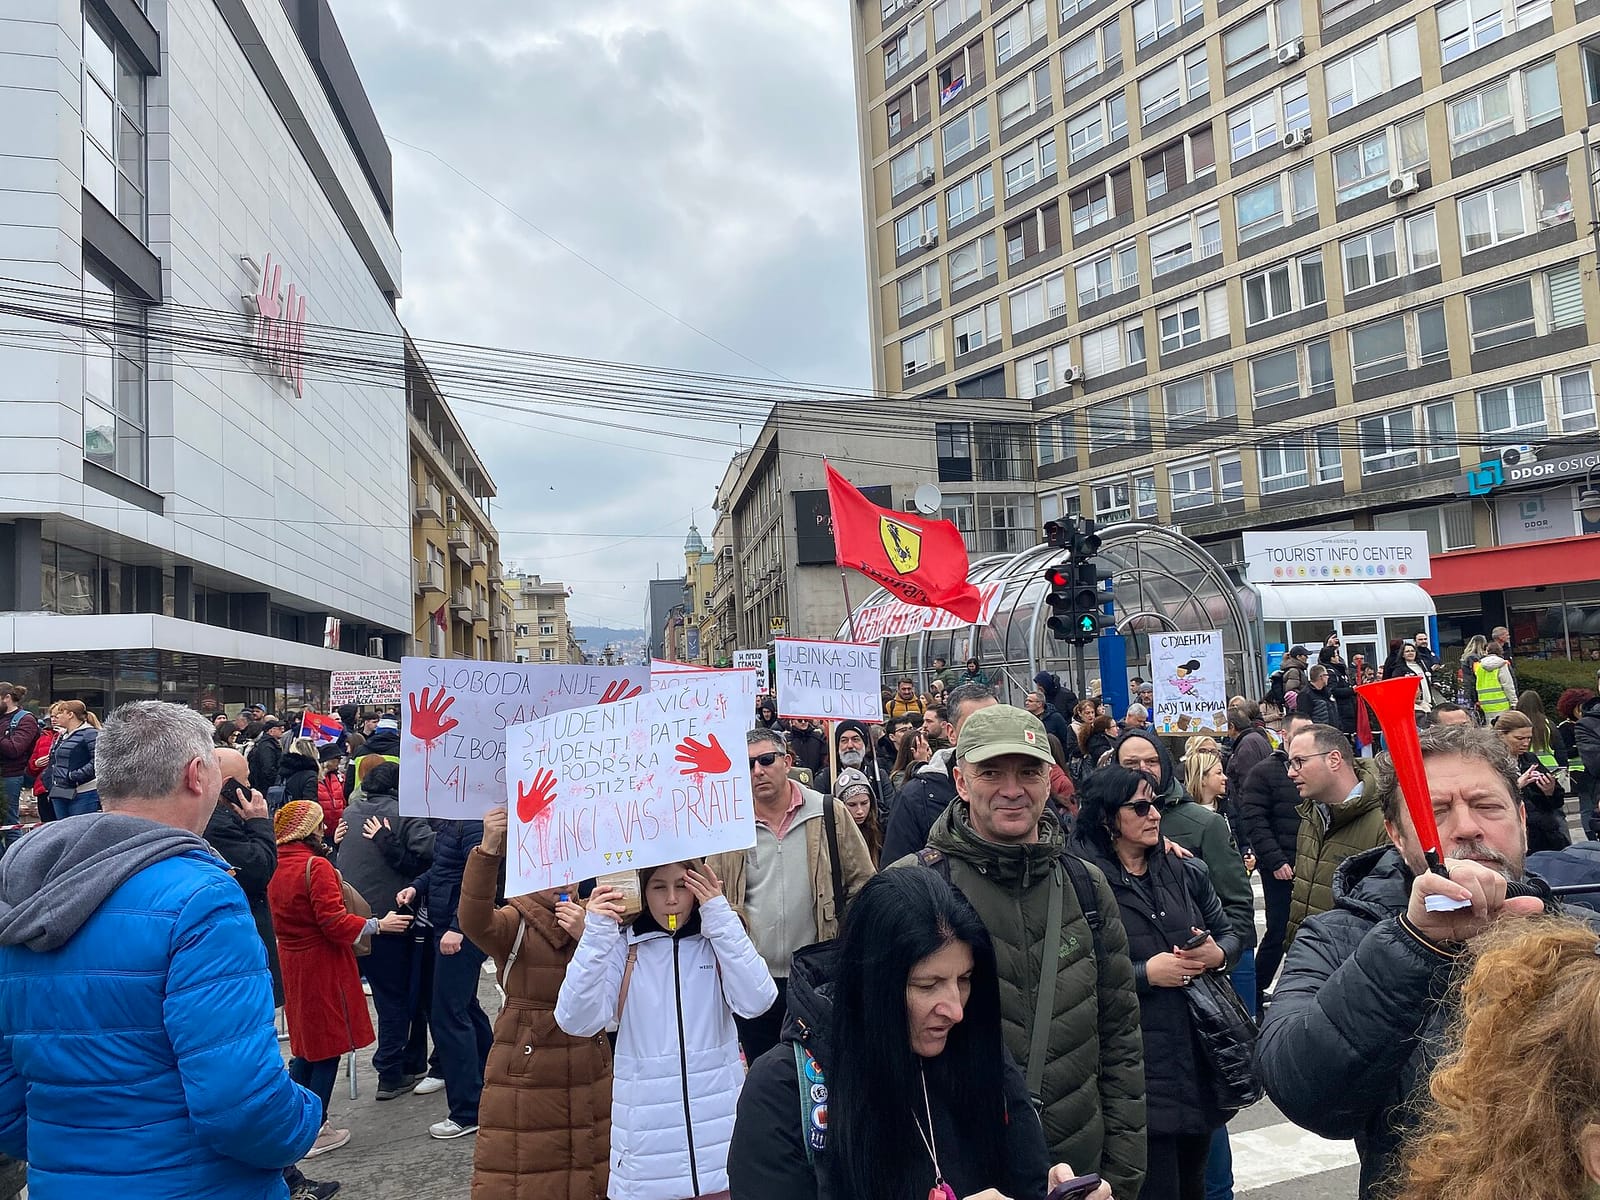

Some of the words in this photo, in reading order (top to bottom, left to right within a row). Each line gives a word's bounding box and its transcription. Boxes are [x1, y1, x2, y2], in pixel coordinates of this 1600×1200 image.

[1511, 464, 1555, 480] DDOR
[1525, 519, 1548, 528] DDOR
[1265, 547, 1323, 562] TOURIST
[1329, 547, 1359, 560] INFO
[1362, 546, 1413, 560] CENTER
[1160, 633, 1212, 649] СТУДЕНТИ
[427, 665, 531, 696] SLOBODA
[557, 672, 600, 696] NIJE
[784, 668, 821, 689] TATA
[829, 671, 852, 691] IDE
[822, 695, 832, 714] U
[1156, 702, 1178, 715] ДАЈУ
[1180, 701, 1193, 712] ТИ
[1194, 700, 1227, 713] КРИЛА
[522, 701, 640, 749] STUDENTI
[522, 735, 629, 771] STUDENTI
[562, 752, 659, 783] PODRŠKA
[584, 775, 638, 800] STIŽE
[516, 805, 598, 877] KLINCI
[615, 797, 660, 844] VAS
[671, 776, 745, 838] PRATE
